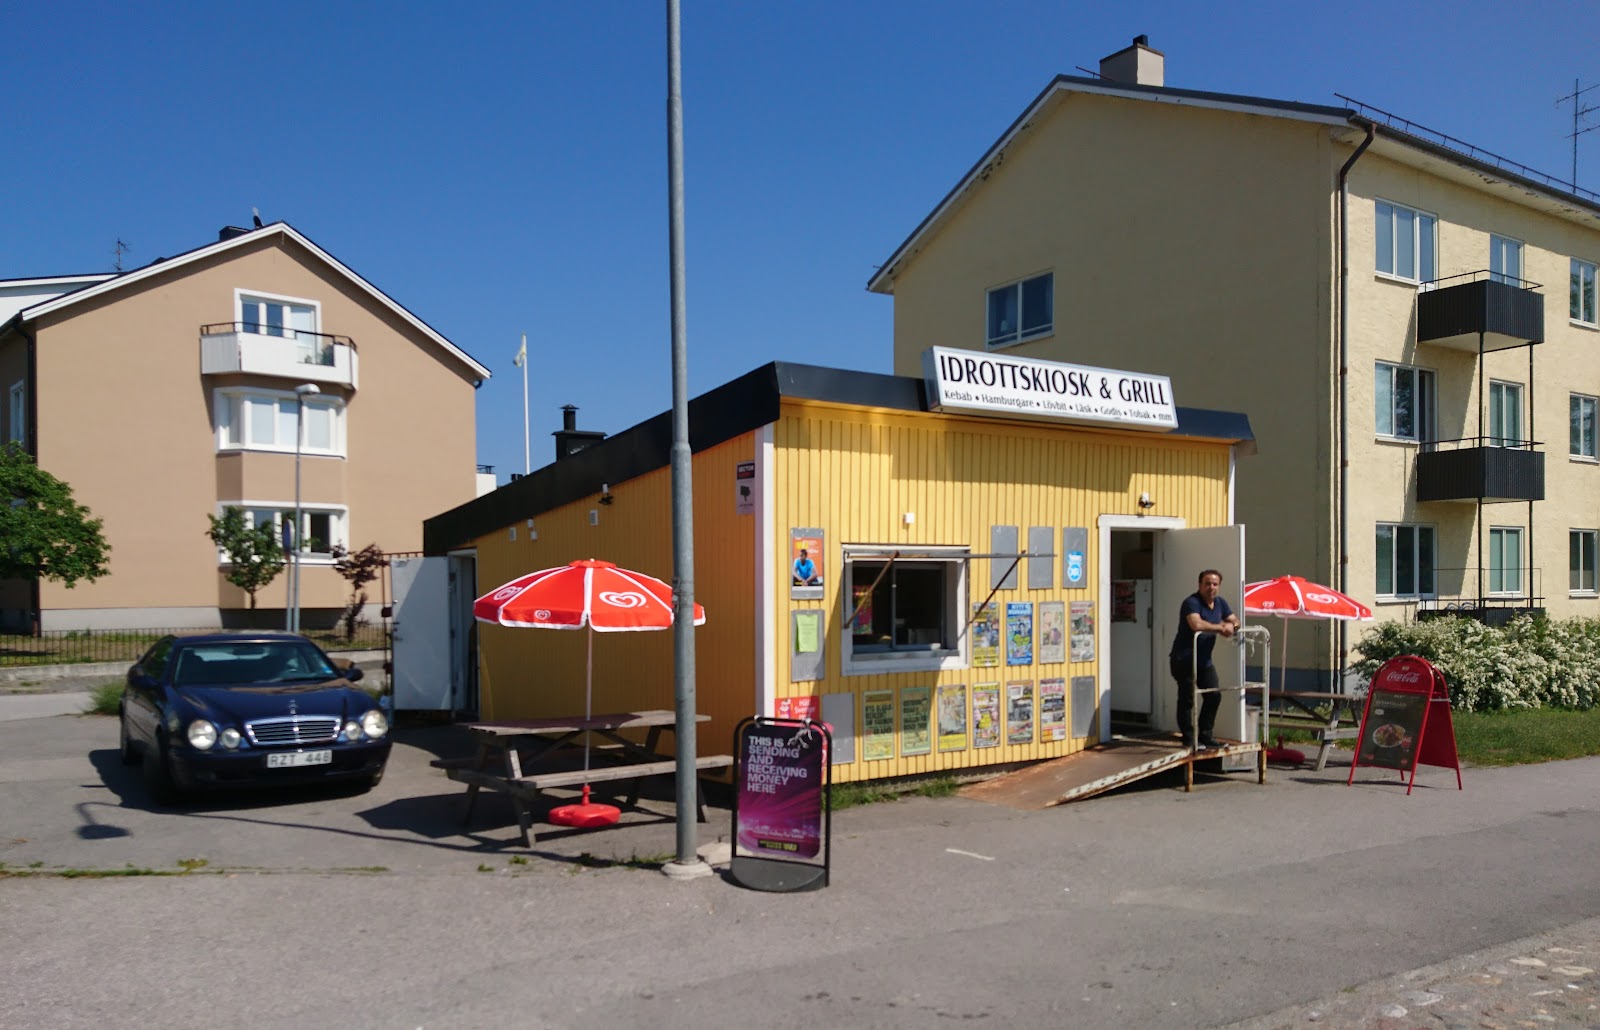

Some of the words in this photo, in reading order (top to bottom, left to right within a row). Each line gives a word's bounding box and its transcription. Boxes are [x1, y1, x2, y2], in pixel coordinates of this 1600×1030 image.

[941, 355, 1092, 398] IDROTTSKIOSK
[1100, 377, 1112, 399] &
[1119, 378, 1169, 406] GRILL
[944, 389, 972, 401] Kebab
[981, 394, 1034, 408] Hamburgare
[1386, 671, 1421, 683] Coca-Cola
[749, 735, 772, 746] THIS
[774, 738, 784, 748] IS
[749, 745, 799, 758] SENDING
[271, 754, 296, 766] RZT
[748, 755, 774, 765] AND
[748, 764, 808, 778] RECEIVING
[747, 773, 789, 785] MONEY
[747, 783, 776, 794] HERE
